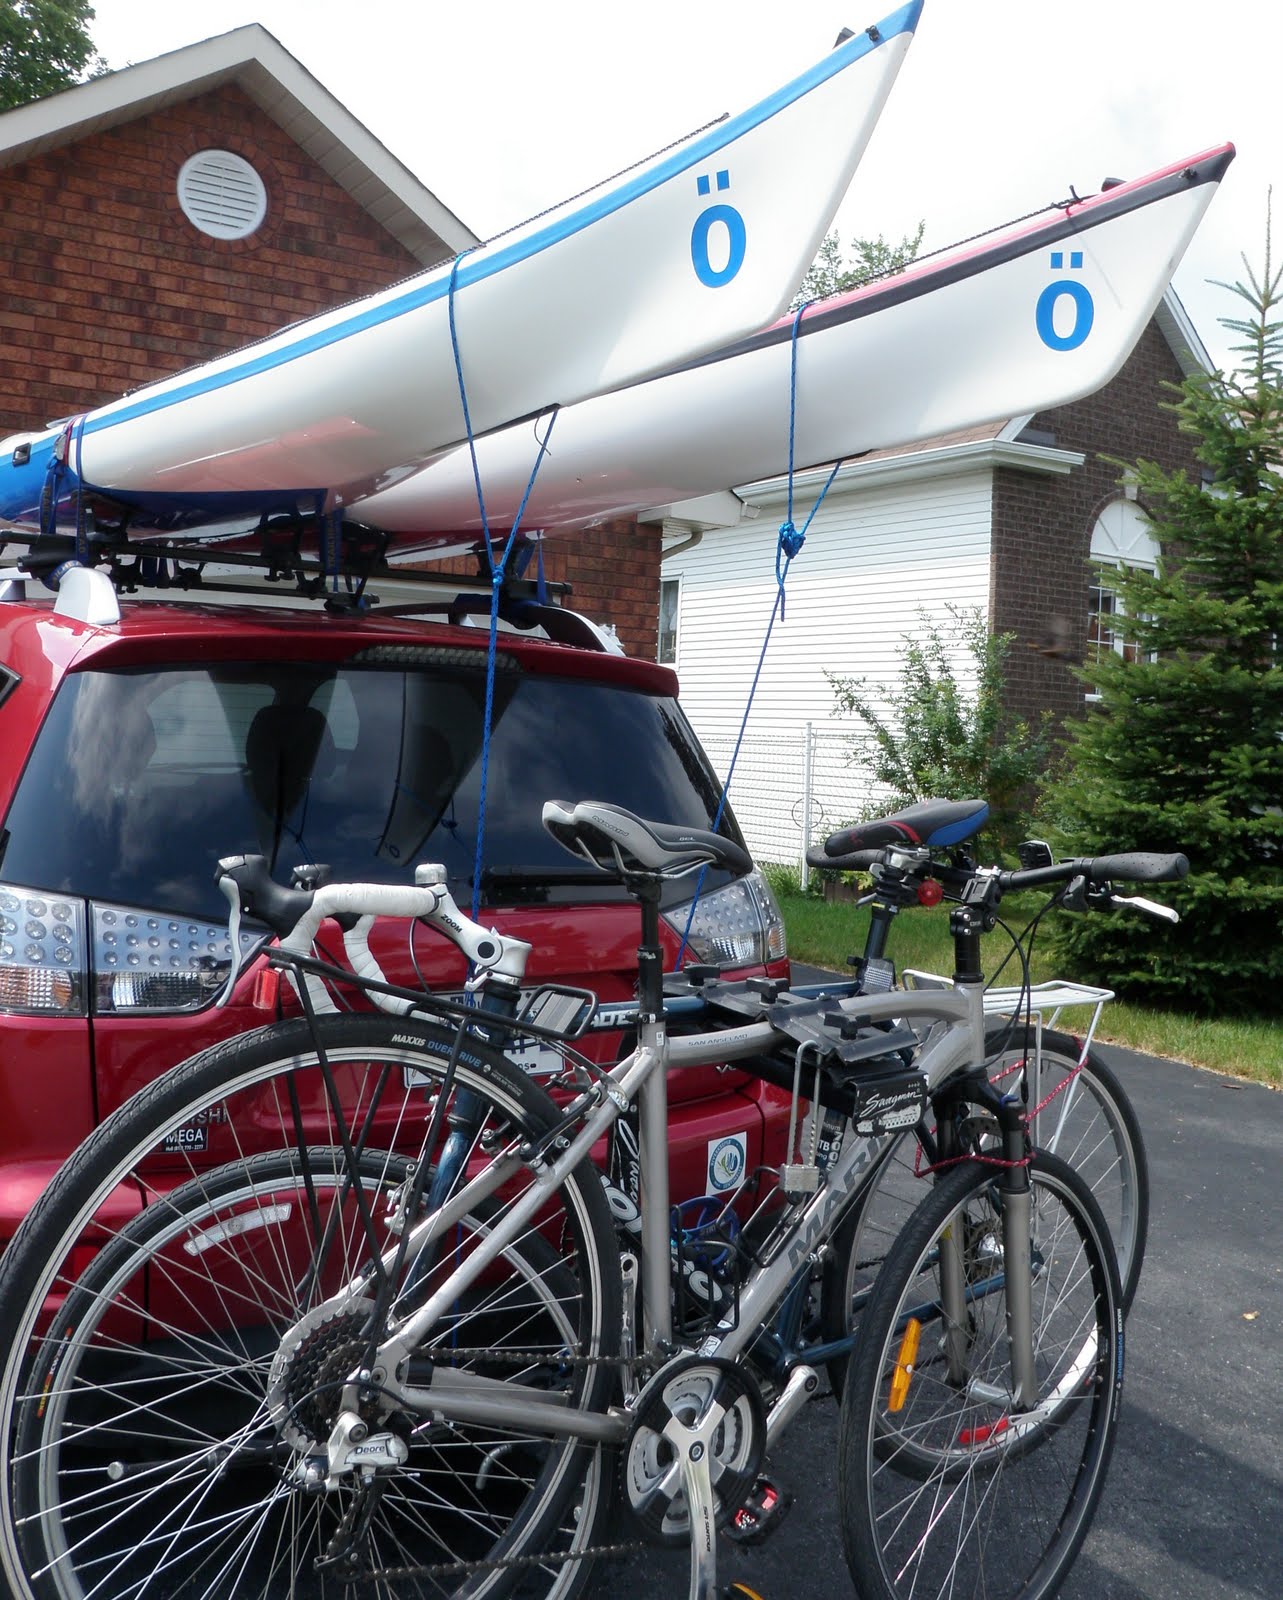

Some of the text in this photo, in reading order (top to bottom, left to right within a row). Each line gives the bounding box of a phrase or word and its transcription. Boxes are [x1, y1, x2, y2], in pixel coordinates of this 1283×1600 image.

[440, 913, 463, 933] ZOOM
[391, 1034, 427, 1047] MAXXIS
[427, 1040, 483, 1068] OVERRIVE
[355, 1446, 385, 1455] Deore
